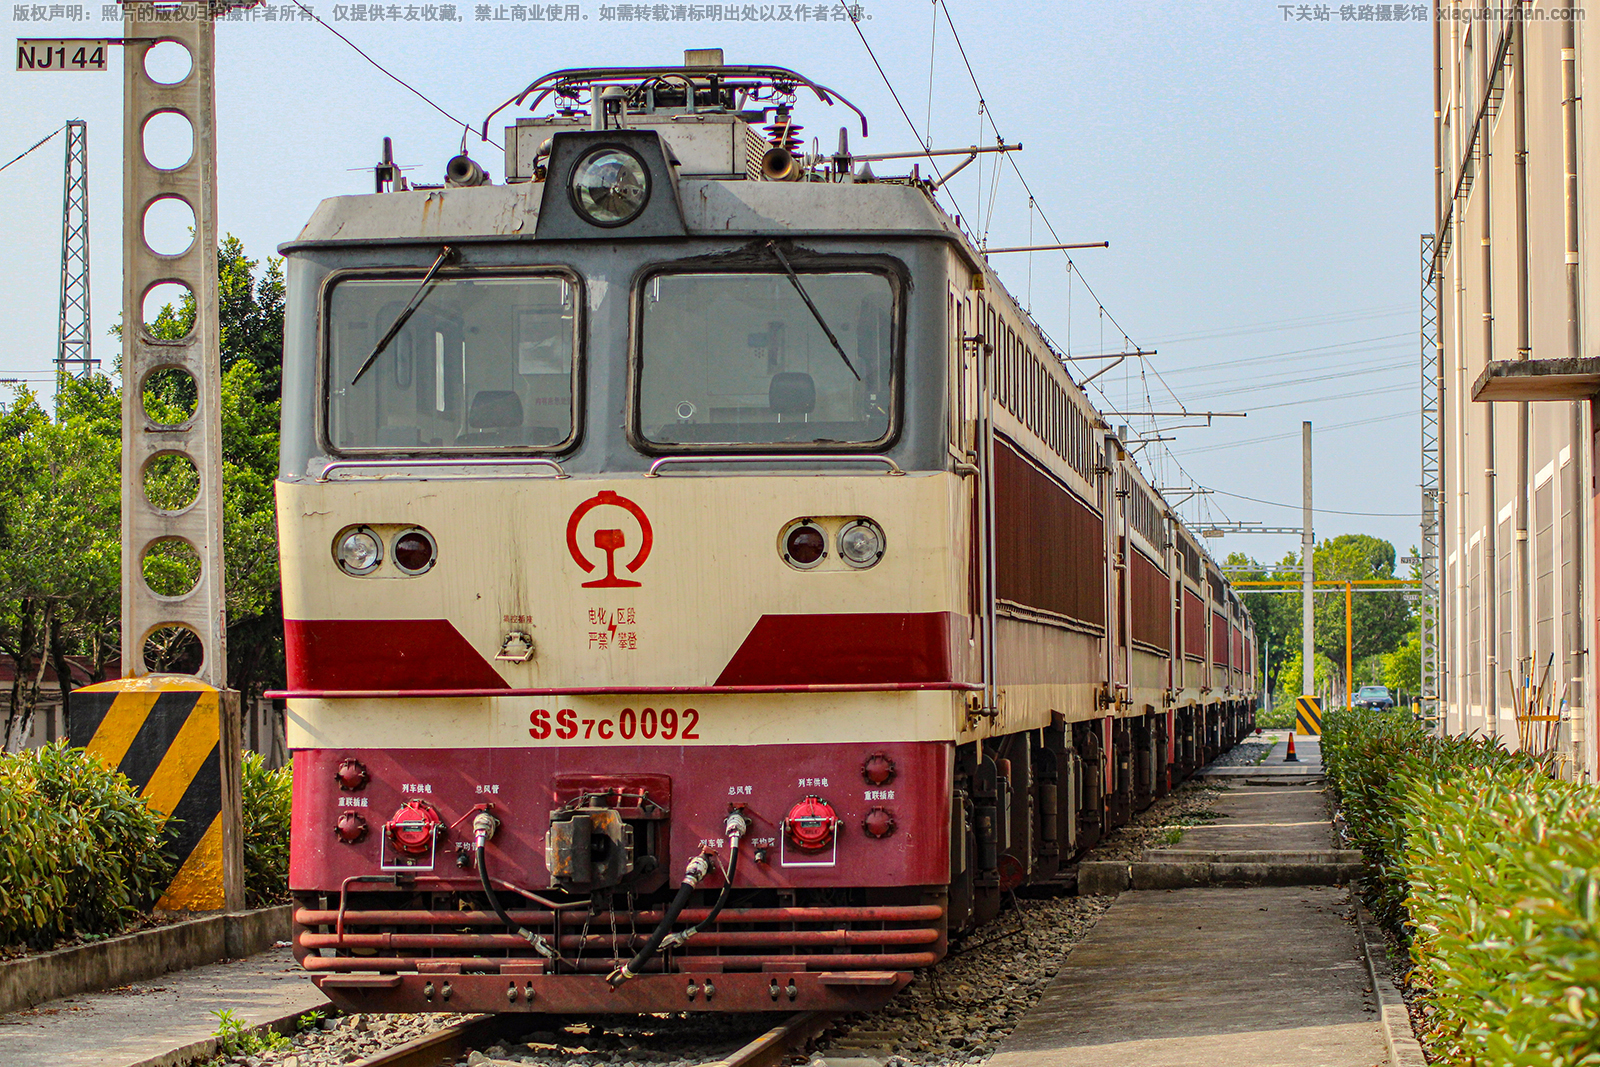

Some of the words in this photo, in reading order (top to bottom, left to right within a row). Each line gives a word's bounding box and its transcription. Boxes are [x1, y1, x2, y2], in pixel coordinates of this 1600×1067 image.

[17, 46, 106, 70] NJ144
[798, 778, 829, 787] 列车供电
[402, 783, 432, 794] 列车供电
[475, 784, 500, 794] 总风管
[728, 785, 753, 795] 总风管
[864, 790, 895, 801] 重联插座
[338, 797, 368, 808] 重联插座
